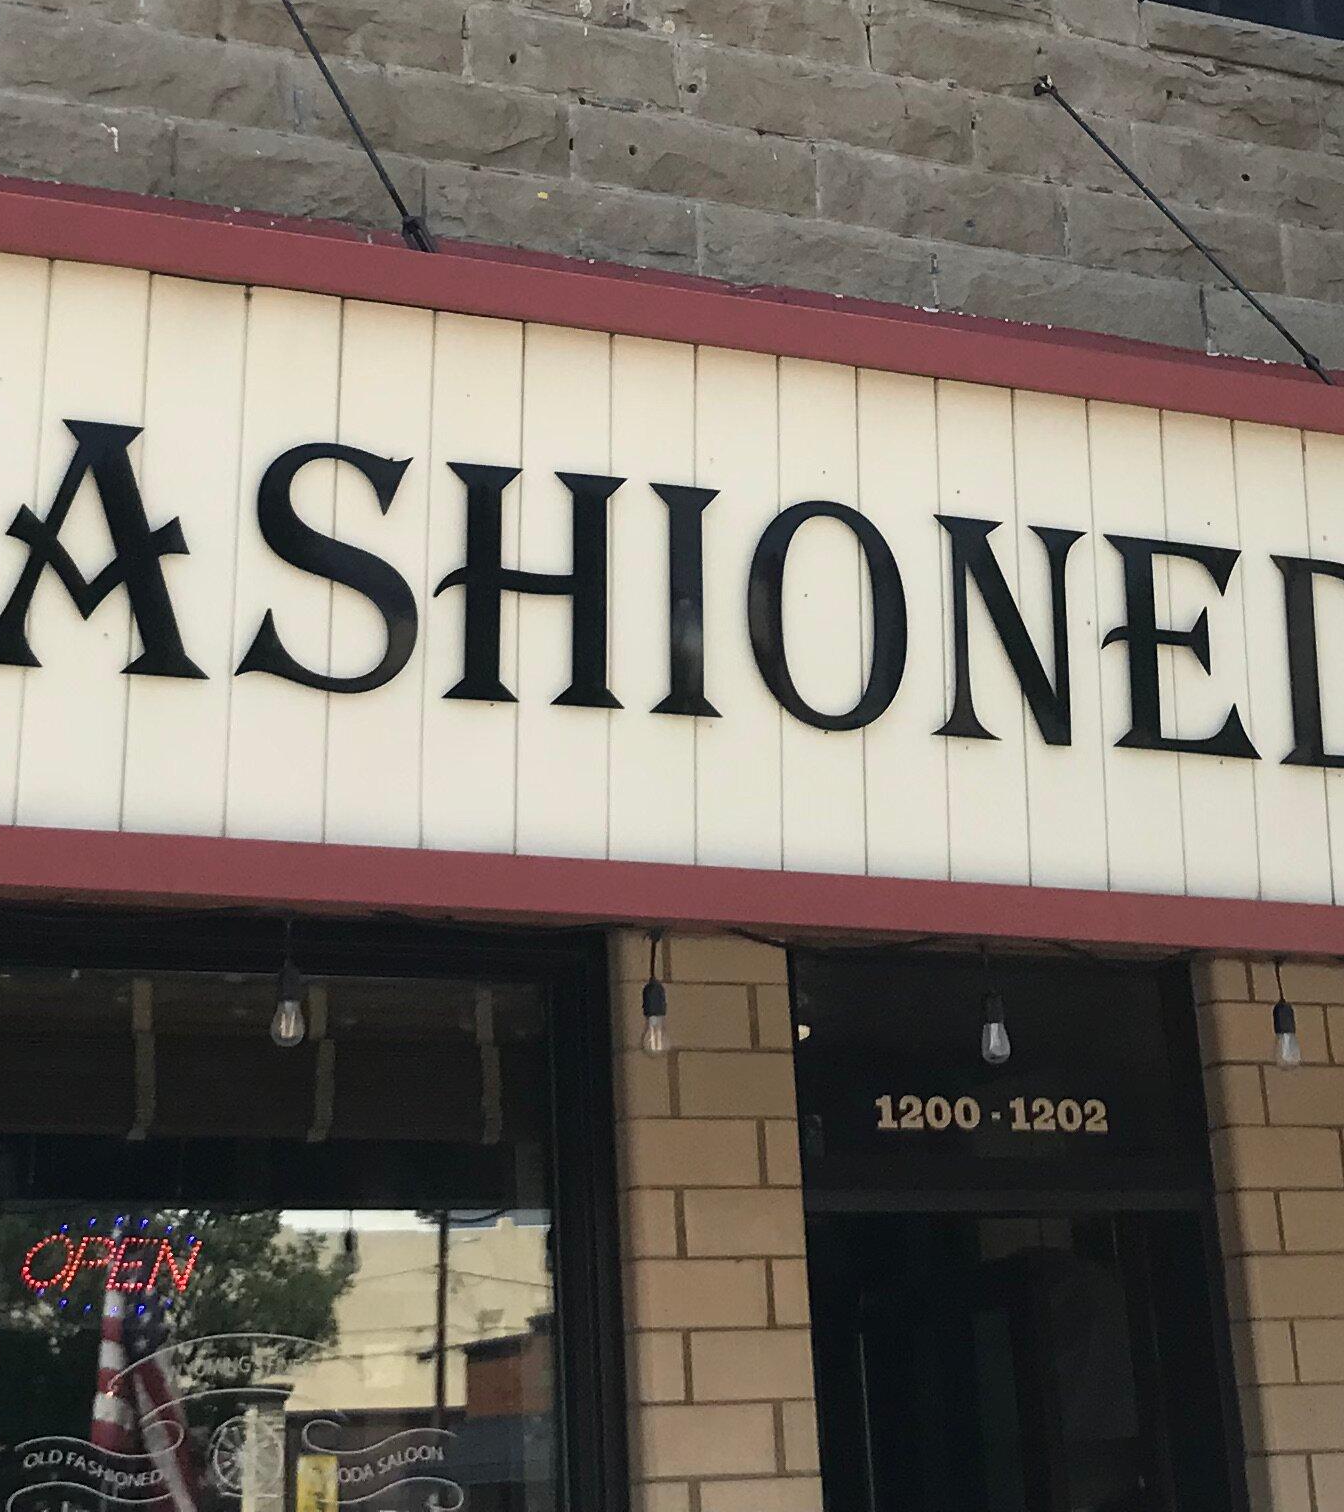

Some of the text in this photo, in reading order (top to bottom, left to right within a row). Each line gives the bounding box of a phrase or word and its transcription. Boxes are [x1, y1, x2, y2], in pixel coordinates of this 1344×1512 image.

[874, 1093, 982, 1131] 1200
[1008, 1095, 1109, 1134] 1202
[20, 1233, 204, 1294] OPEN
[22, 1448, 64, 1469] OLD
[376, 1444, 445, 1475] SALOON
